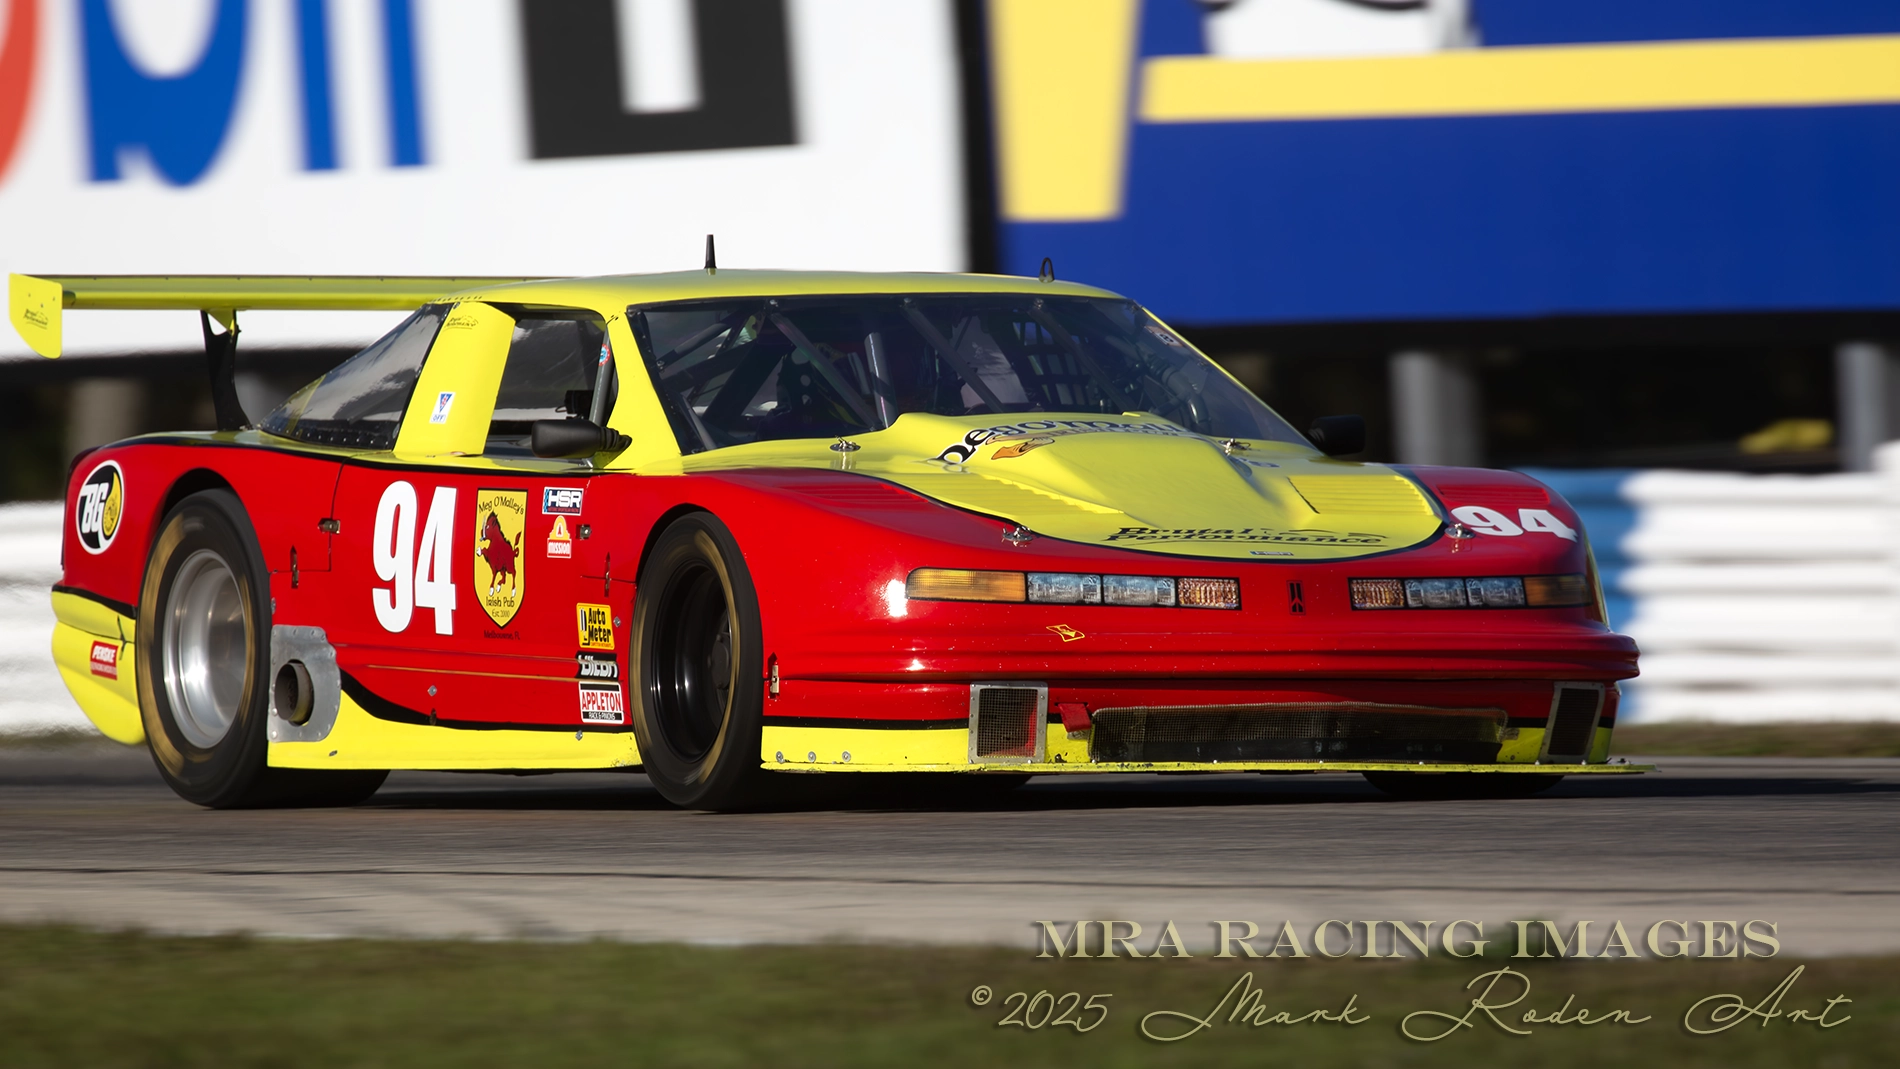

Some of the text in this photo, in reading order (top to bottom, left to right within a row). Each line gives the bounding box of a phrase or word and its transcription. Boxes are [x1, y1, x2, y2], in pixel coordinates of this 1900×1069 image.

[81, 482, 110, 534] BG
[478, 496, 525, 516] Meg O'Malley's
[548, 489, 582, 508] HSR
[1117, 527, 1254, 535] Brutal
[1451, 505, 1578, 543] 94
[1101, 533, 1382, 543] Performance
[372, 480, 458, 636] 94
[485, 596, 515, 608] Irish Pub
[588, 607, 606, 625] Auto
[588, 624, 612, 643] Meter
[582, 691, 622, 712] APPLETON
